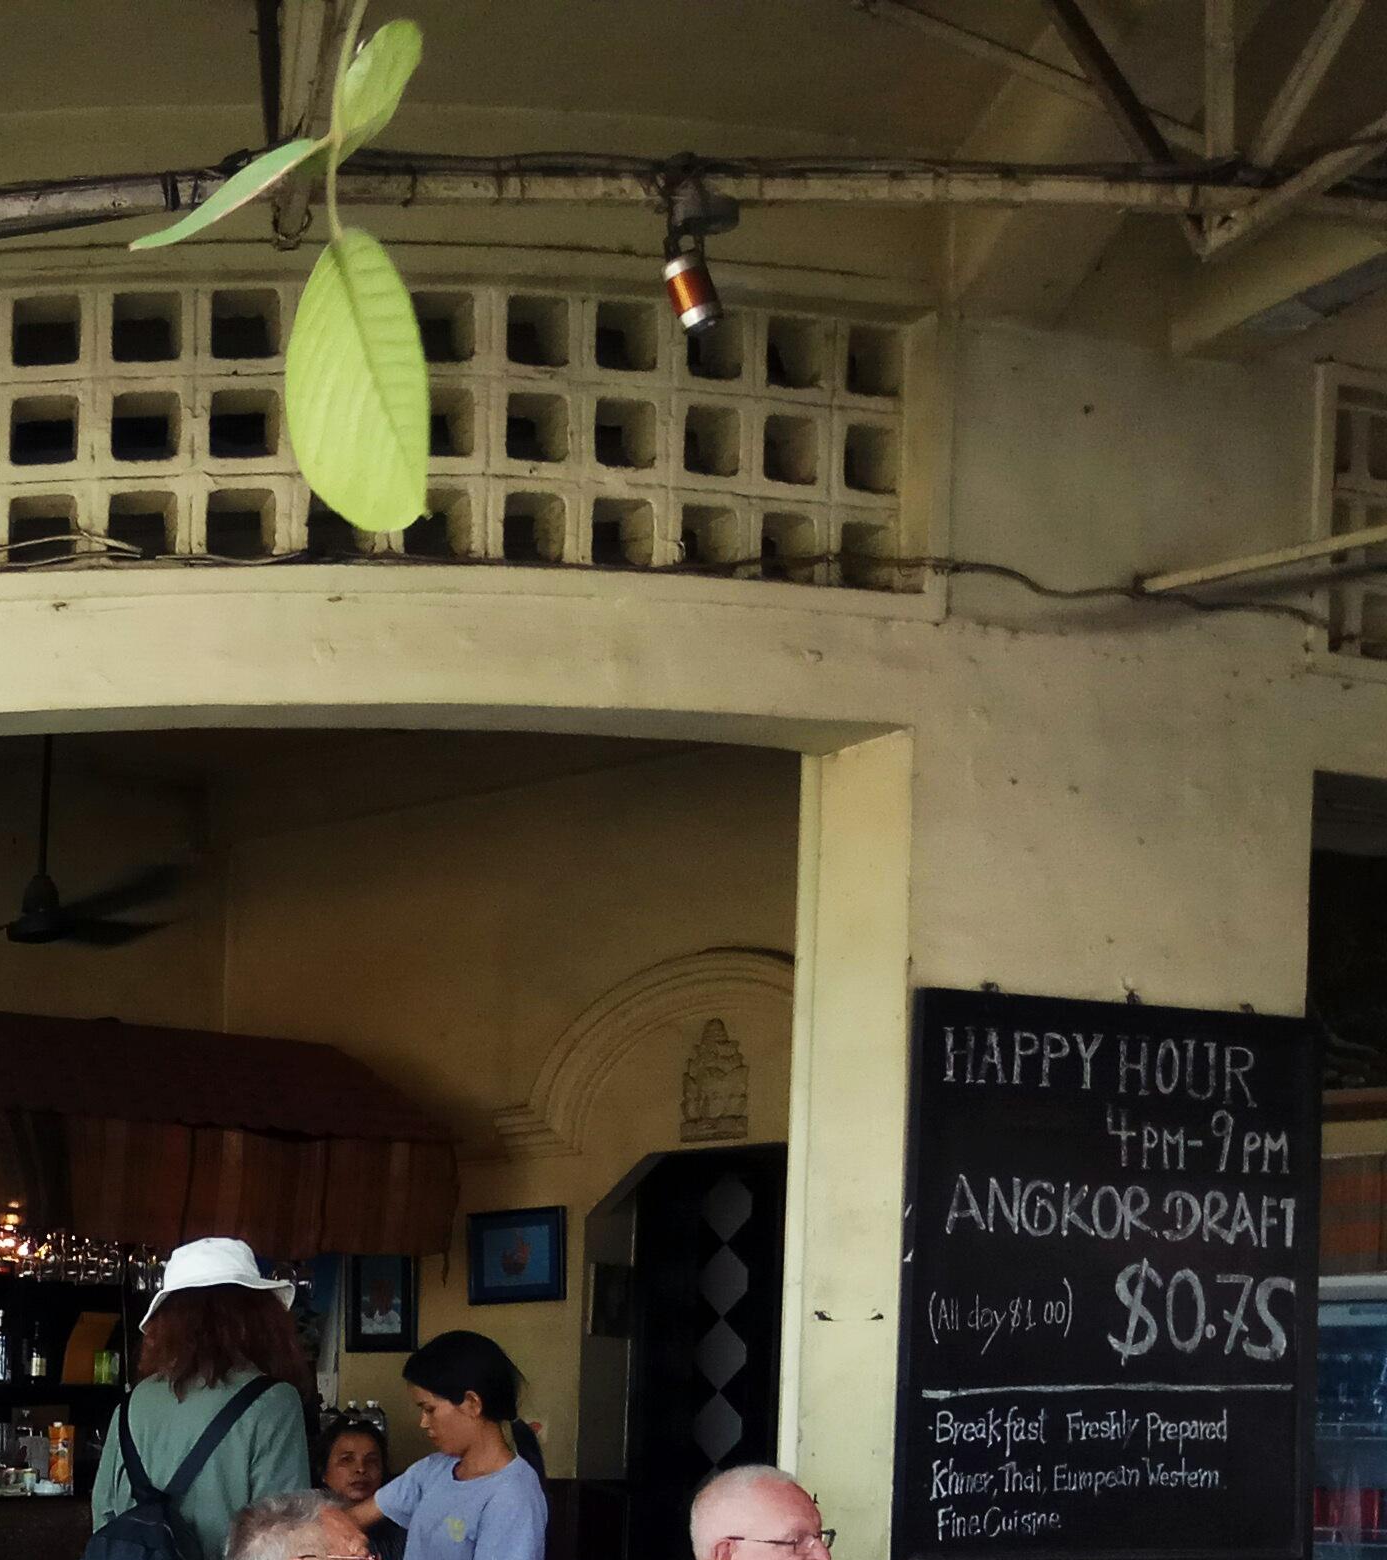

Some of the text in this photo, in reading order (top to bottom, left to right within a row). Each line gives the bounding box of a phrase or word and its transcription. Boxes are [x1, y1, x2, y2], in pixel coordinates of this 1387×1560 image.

[942, 1026, 1257, 1108] HAPPY HOUR
[945, 1173, 1296, 1248] ANGKOR DRAFT
[1106, 1256, 1297, 1368] $0.75
[1065, 1408, 1140, 1450] Freshly
[1145, 1408, 1228, 1455] Prepared
